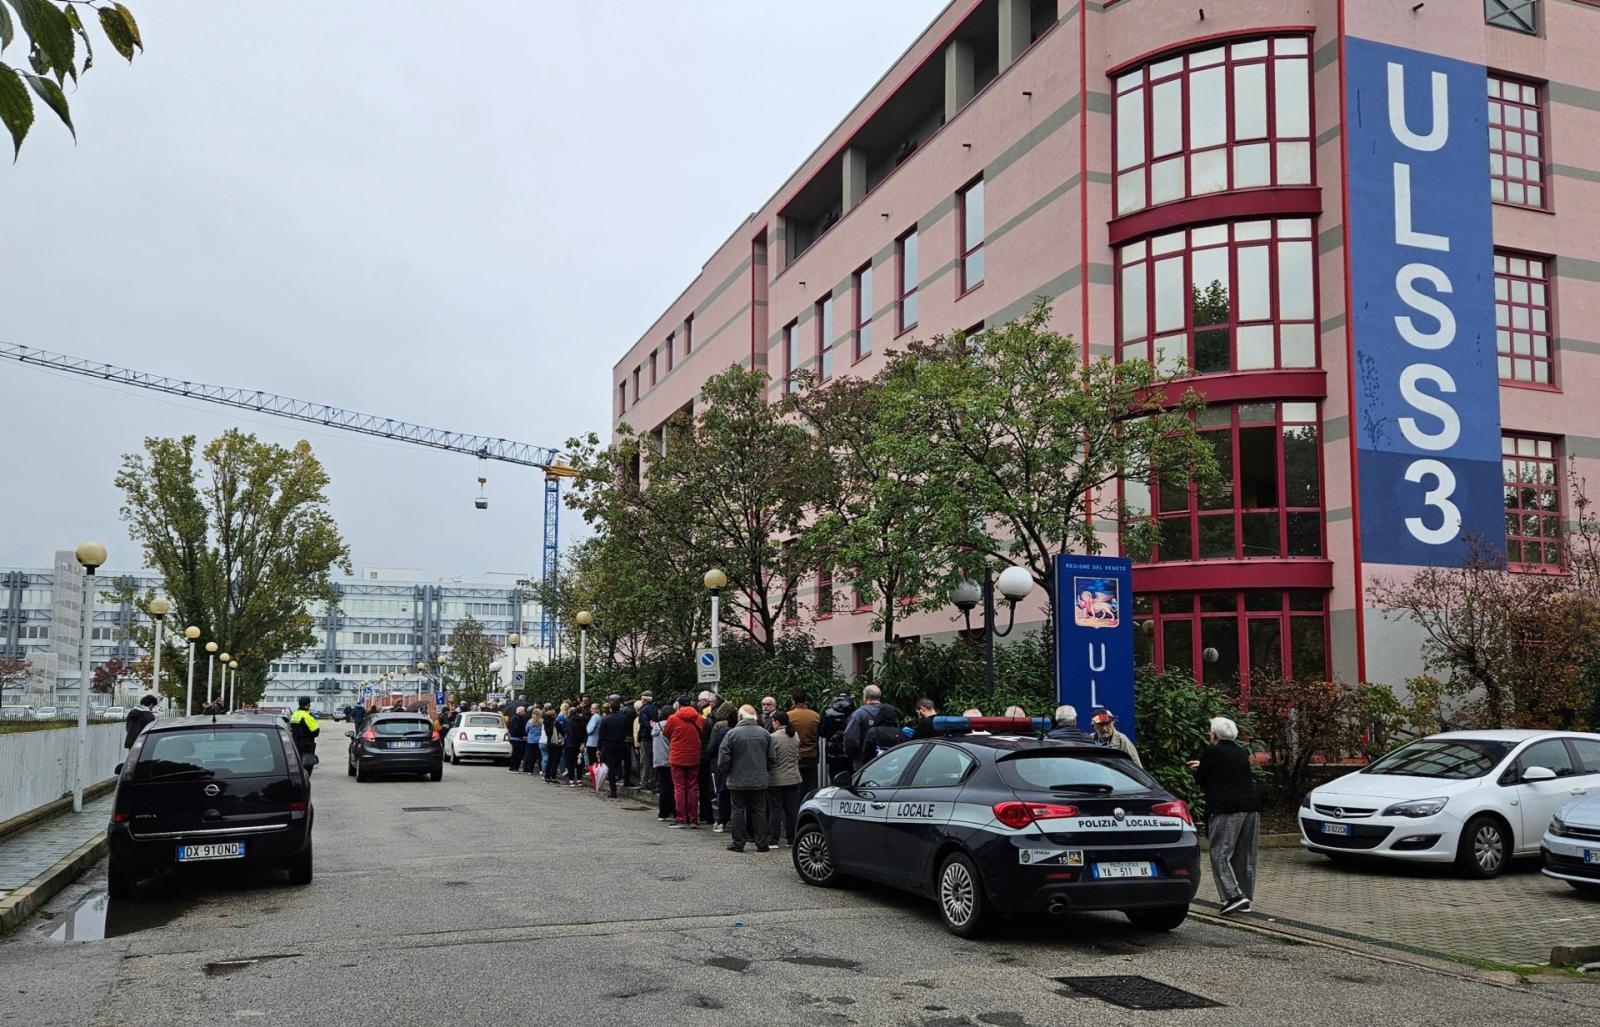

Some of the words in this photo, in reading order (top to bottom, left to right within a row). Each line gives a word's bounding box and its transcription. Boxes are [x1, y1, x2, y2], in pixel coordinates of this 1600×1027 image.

[840, 802, 866, 814] POLIZIA
[897, 803, 935, 817] LOCALE
[1078, 820, 1118, 828] POLIZIA
[1125, 819, 1159, 827] LOCALE
[186, 847, 200, 857] DX
[203, 844, 238, 855] 910ND
[1058, 856, 1068, 864] 15
[1102, 867, 1112, 877] YA
[1120, 867, 1133, 876] 511
